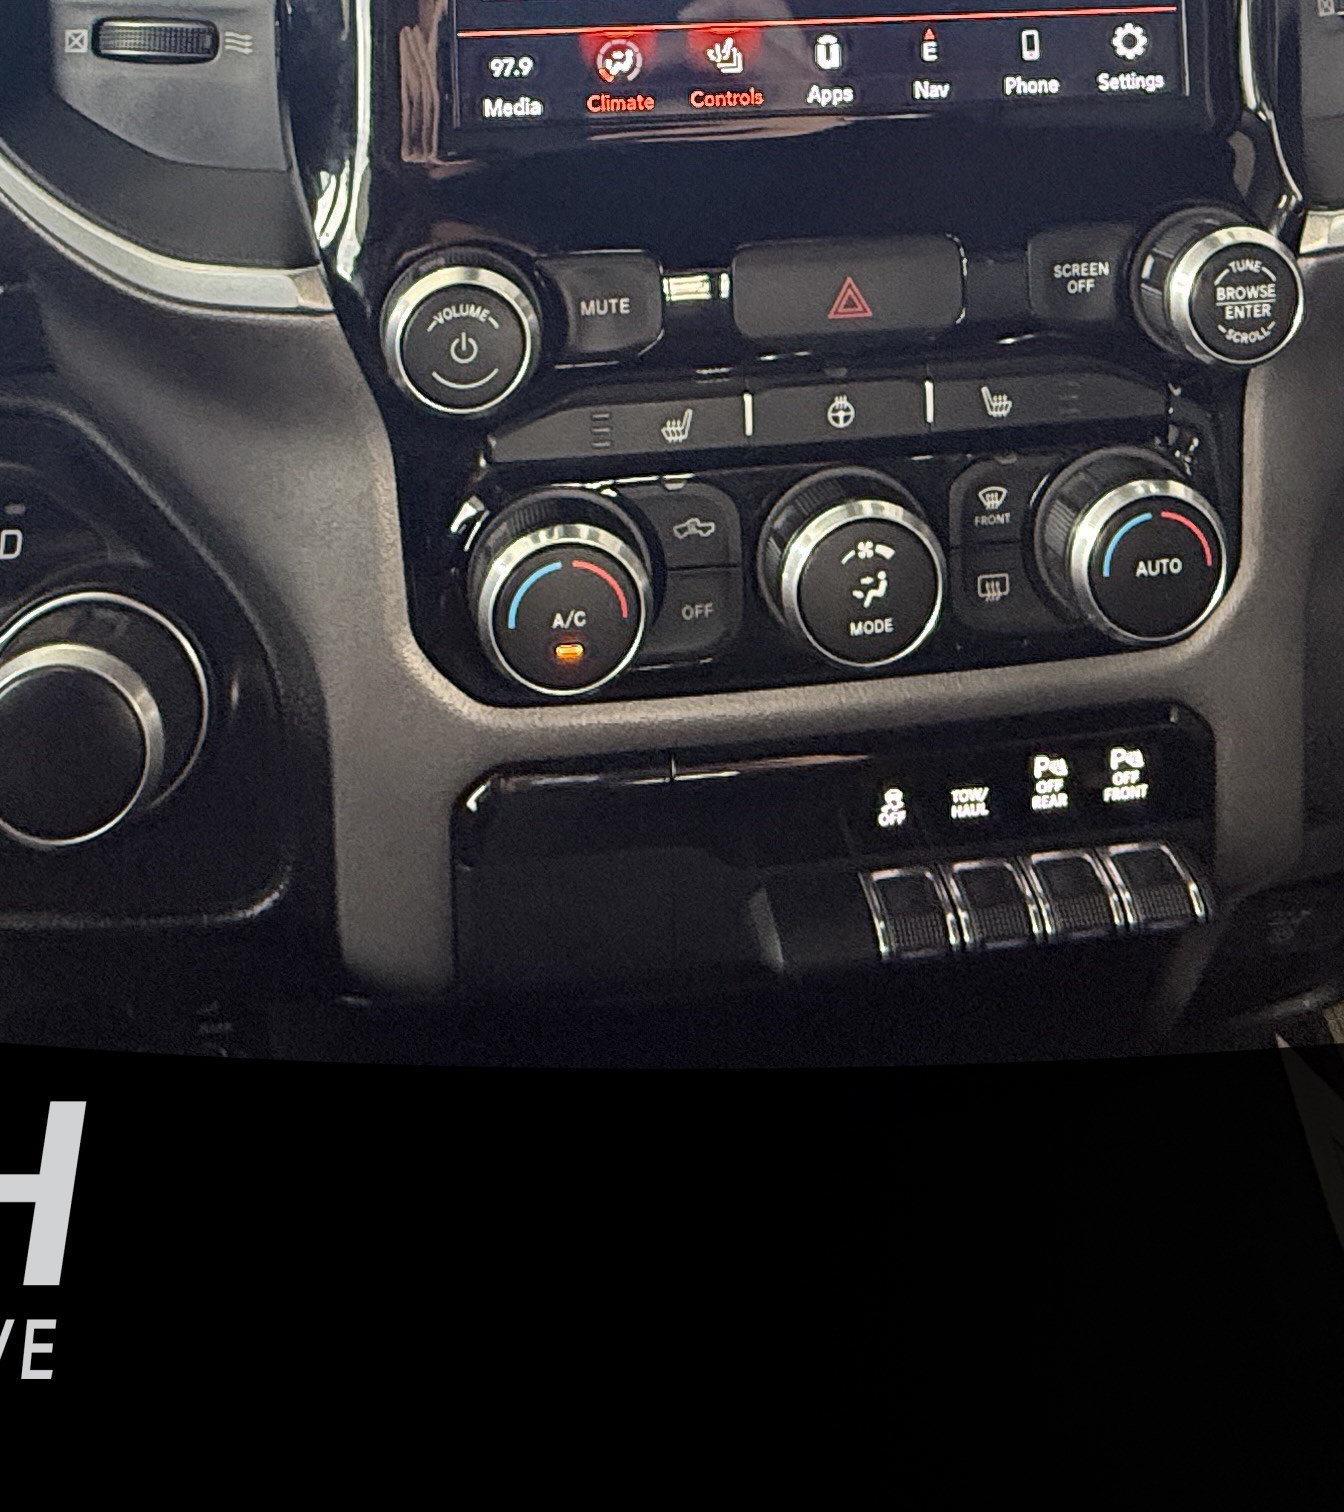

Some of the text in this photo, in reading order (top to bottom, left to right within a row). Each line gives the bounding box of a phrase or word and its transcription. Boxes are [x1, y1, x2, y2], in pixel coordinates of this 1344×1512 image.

[489, 56, 535, 78] 97.9
[913, 80, 951, 99] Nav
[1004, 76, 1060, 95] Phone
[1097, 72, 1165, 93] Settings
[586, 94, 655, 113] Climate
[690, 87, 764, 108] Controls
[806, 85, 855, 107] Apps
[483, 97, 543, 118] Media
[1054, 262, 1110, 278] SCREEN
[1228, 259, 1262, 274] TUNE
[1067, 279, 1095, 294] OFF
[1216, 284, 1276, 301] BROWSE
[433, 304, 491, 325] VOLUME
[580, 298, 631, 316] MUTE
[1225, 304, 1272, 320] ENTER
[1225, 326, 1271, 345] SCROLL
[974, 512, 1011, 527] FRONT
[1135, 558, 1182, 578] AUTO
[552, 612, 587, 629] A/C
[681, 604, 715, 621] OFF
[850, 618, 894, 636] MODE
[1036, 778, 1064, 794] OFF
[1111, 769, 1140, 785] OFF
[1031, 793, 1068, 810] REAR
[1103, 783, 1148, 802] FRONT
[878, 810, 906, 827] OFF
[951, 803, 989, 819] HAUL
